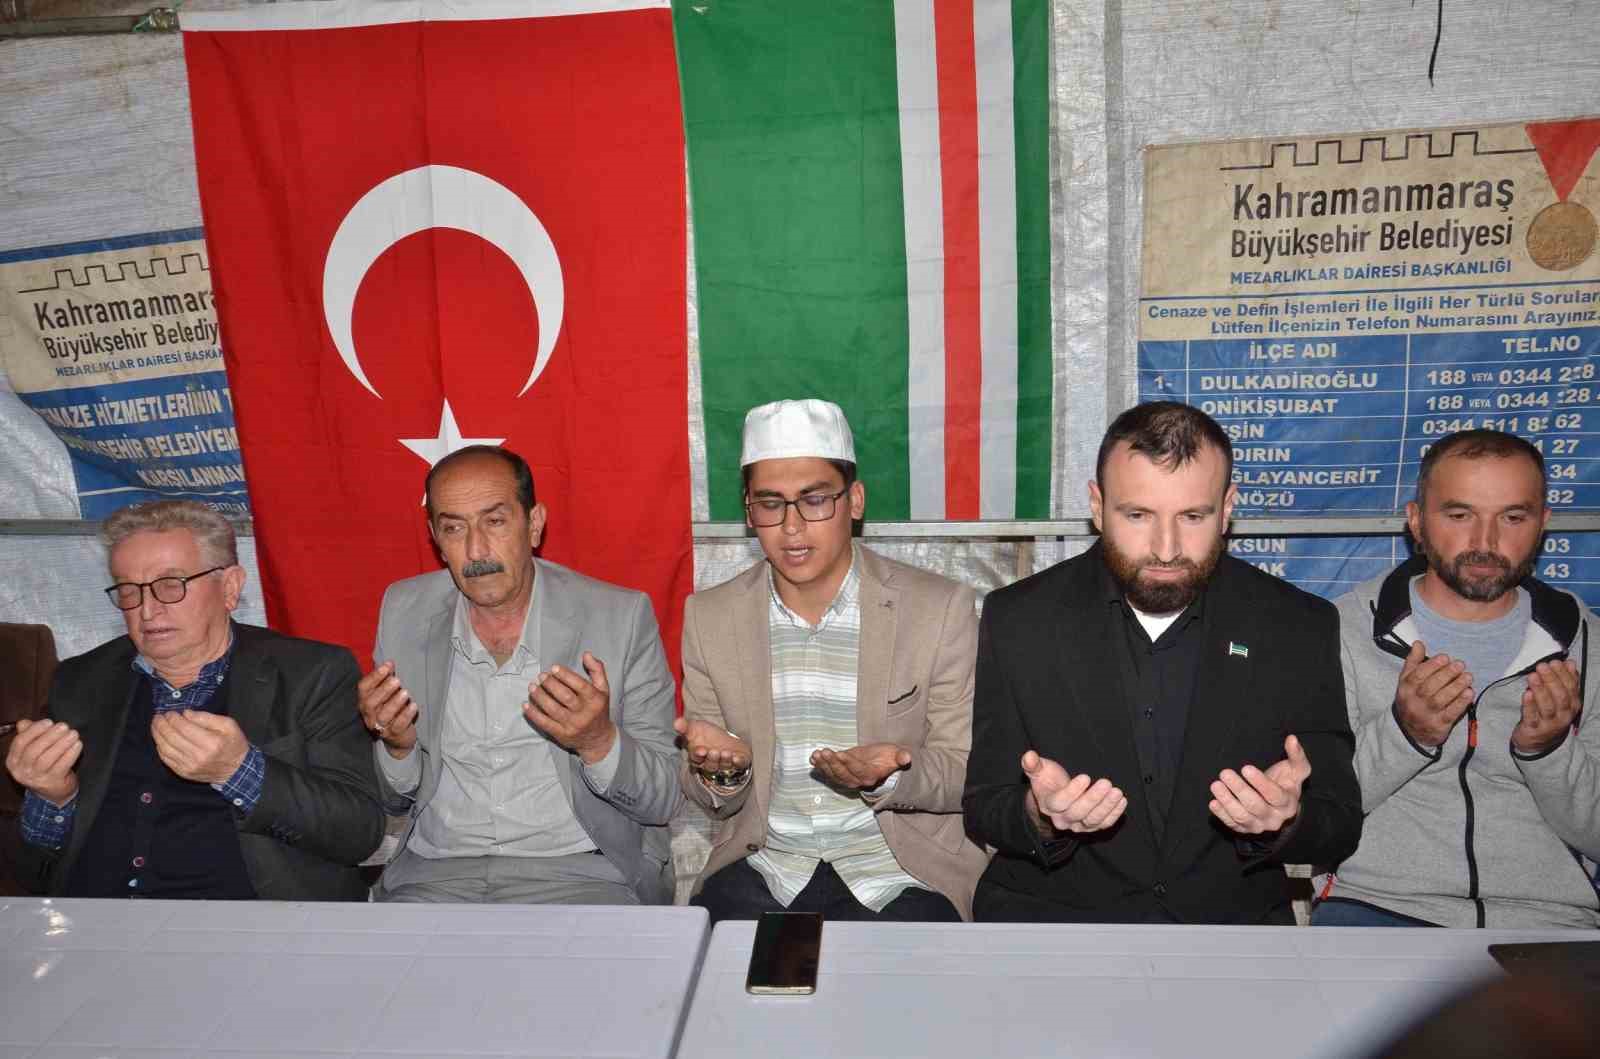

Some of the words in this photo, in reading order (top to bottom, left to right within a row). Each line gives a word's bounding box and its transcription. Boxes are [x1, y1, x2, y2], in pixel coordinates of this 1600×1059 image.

[1232, 178, 1514, 221] Kahramanmaraş
[1231, 227, 1370, 264] Büyükşehir
[1380, 217, 1513, 256] Belediyesi
[1231, 268, 1338, 285] MEZARLIKLAR
[1344, 261, 1406, 280] DAİRESİ
[1411, 257, 1512, 278] BAŞKANLIĞI
[1149, 304, 1207, 318] Cenaze
[1212, 306, 1231, 317] ve
[1237, 303, 1279, 316] Defin
[1285, 298, 1360, 318] İşlemleri
[1366, 295, 1388, 312] İle
[1394, 294, 1433, 313] İlgili
[1440, 295, 1471, 309] Her
[1476, 293, 1525, 307] Türlü
[1211, 320, 1263, 334] Lütfen
[1268, 317, 1340, 335] İlçenizin
[1346, 315, 1410, 332] Telefon
[1416, 313, 1518, 328] Numarasını
[43, 326, 148, 362] Büyükşehir
[153, 318, 218, 345] Belediy
[1502, 336, 1581, 353] TEL.NO
[1250, 342, 1295, 363] İLÇE
[1302, 343, 1337, 359] ADI
[56, 358, 135, 377] MEZARLIKLAR
[138, 351, 182, 368] DAİRESİ
[1201, 370, 1377, 390] DULKADİROĞLU
[1427, 370, 1466, 385] 188
[1500, 367, 1552, 385] 0344
[1201, 397, 1339, 417] ONİKİŞUBAT
[1426, 395, 1463, 410] 188
[1497, 391, 1549, 408] 0344
[38, 403, 94, 428] NAZE
[1423, 418, 1475, 434] 0344
[1555, 413, 1581, 428] 62
[93, 433, 146, 460] ŞEHİR
[1232, 447, 1291, 462] DIRIN
[1552, 439, 1580, 454] 27
[1231, 467, 1381, 485] ĞLAYANCERİT
[1550, 464, 1576, 479] 34
[1232, 490, 1295, 506] NÖZÜ
[1547, 489, 1575, 503] 82
[1228, 538, 1286, 553] KSUN
[1544, 538, 1570, 553] 03
[1249, 561, 1286, 577] AK
[1543, 563, 1570, 578] 43
